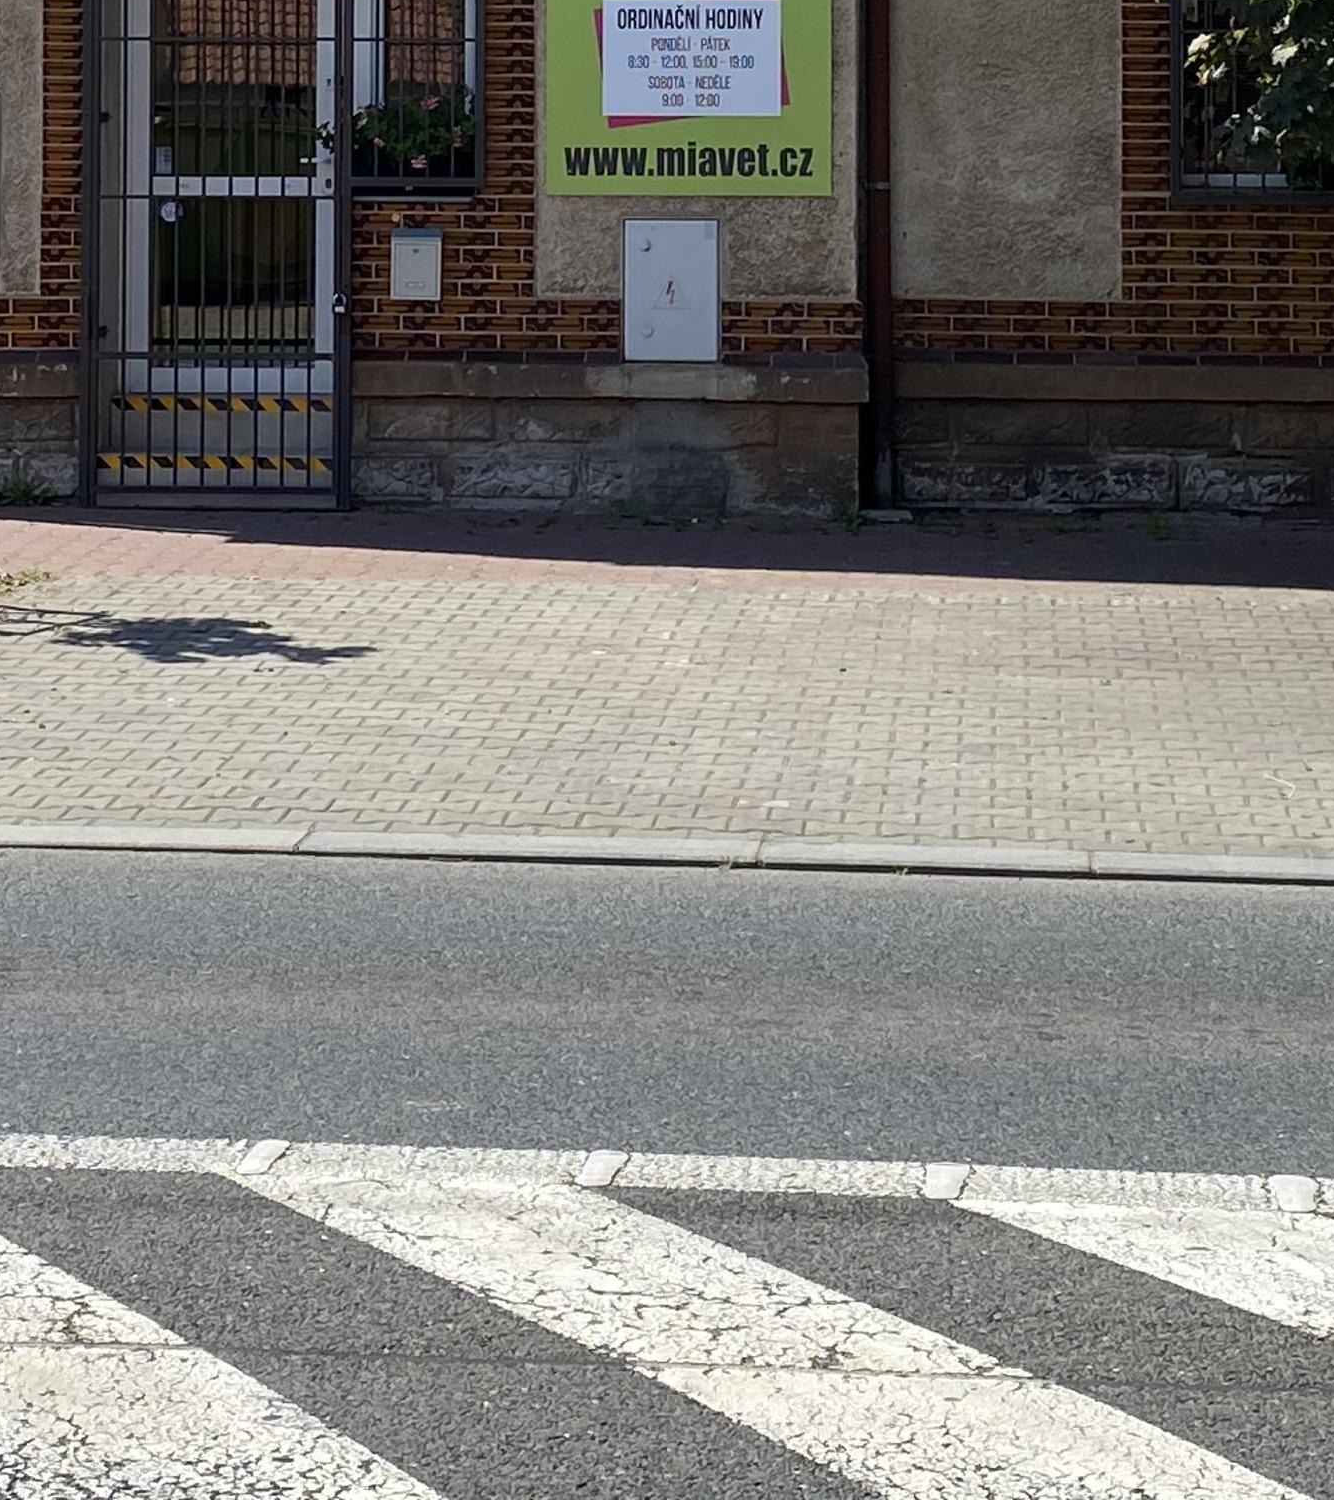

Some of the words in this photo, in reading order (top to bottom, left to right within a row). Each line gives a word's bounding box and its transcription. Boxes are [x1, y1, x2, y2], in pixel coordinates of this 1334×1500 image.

[617, 4, 701, 30] ORDINAČNÍ
[705, 8, 764, 30] HODINY
[700, 35, 731, 52] PÁTEK
[647, 75, 685, 90] SOBOTA
[694, 74, 731, 90] NEDĚLE
[564, 141, 814, 177] www.miavet.cz
